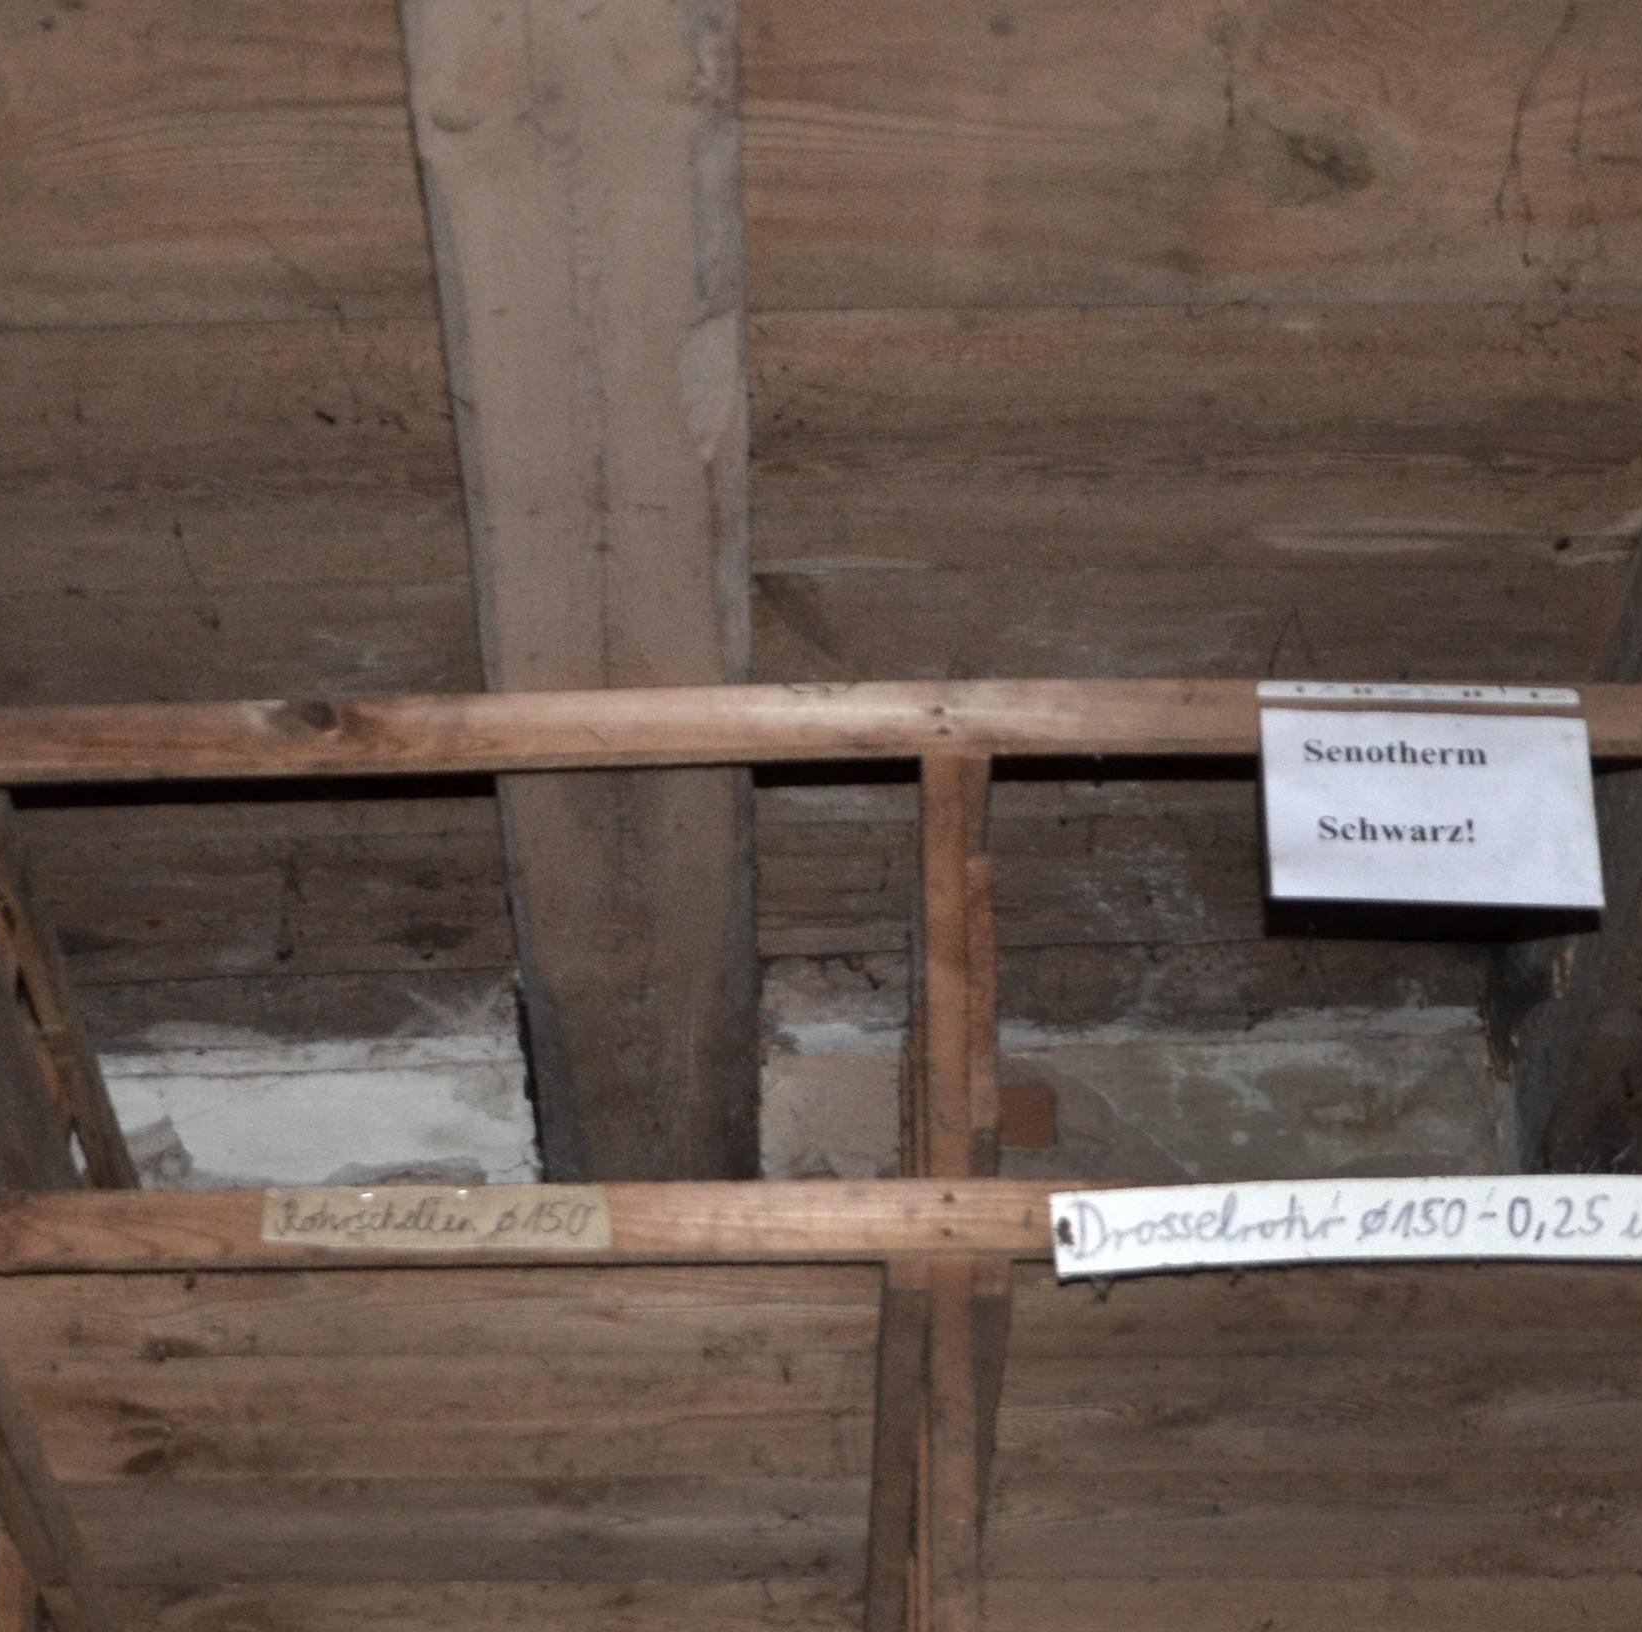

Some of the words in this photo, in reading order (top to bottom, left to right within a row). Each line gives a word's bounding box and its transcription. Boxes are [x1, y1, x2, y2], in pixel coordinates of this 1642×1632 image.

[1303, 739, 1488, 766] Senotherm
[1317, 815, 1477, 844] Schwarz!
[1065, 1191, 1346, 1260] Drosselrohr
